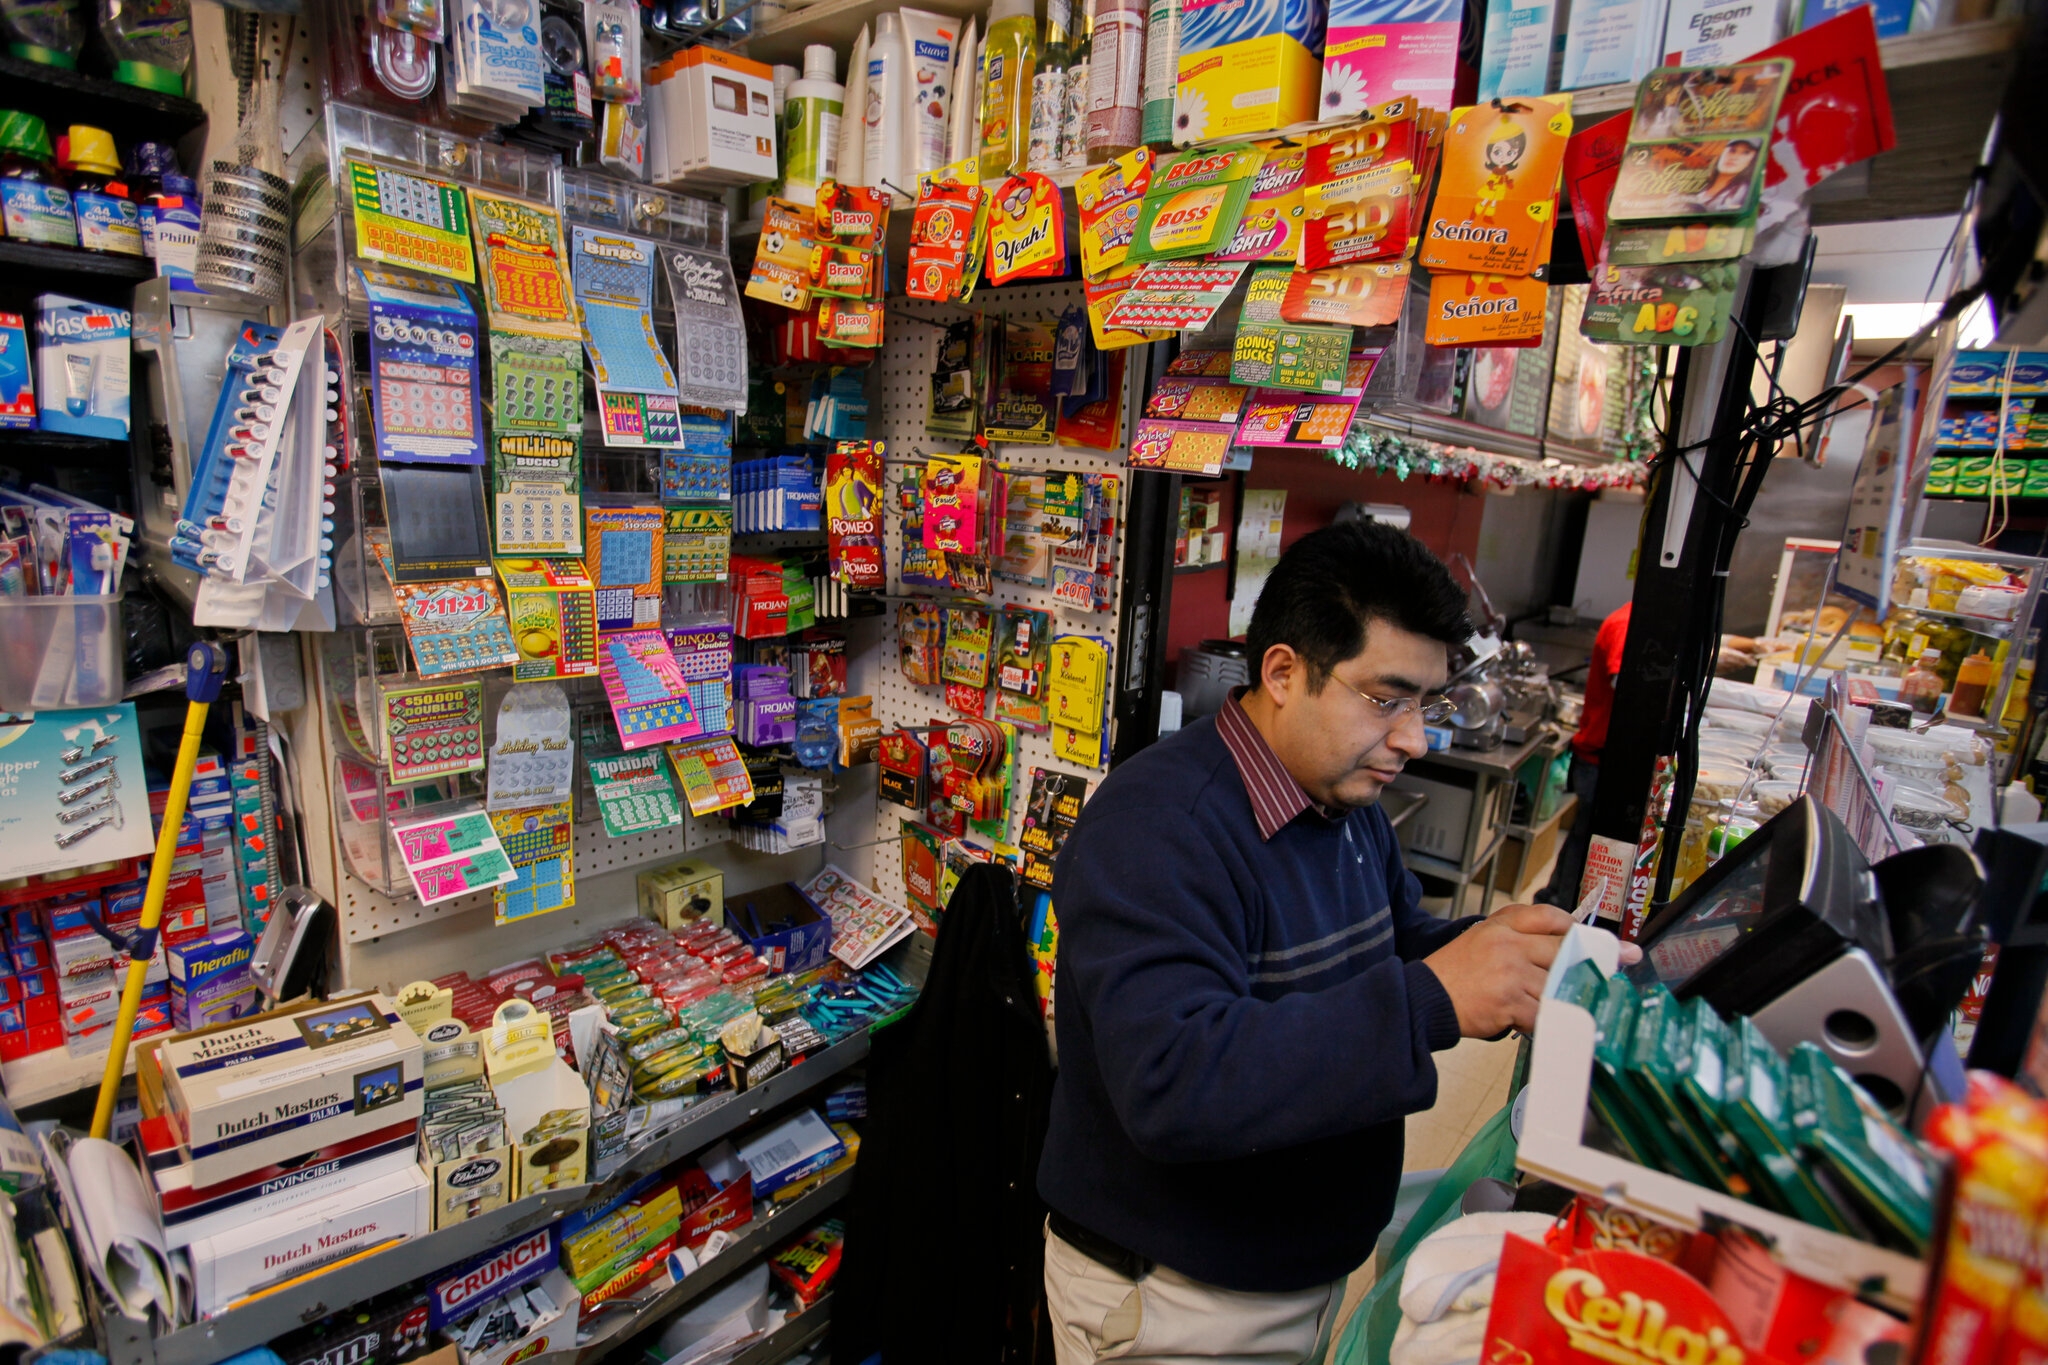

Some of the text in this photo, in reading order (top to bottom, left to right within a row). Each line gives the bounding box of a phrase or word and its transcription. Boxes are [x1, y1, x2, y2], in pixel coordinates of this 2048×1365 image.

[1689, 6, 1752, 30] Epsom
[1699, 23, 1738, 43] Salt
[918, 44, 948, 57] Suave
[1788, 61, 1841, 95] OCK
[1384, 103, 1404, 117] $2
[1550, 122, 1562, 132] $2
[1328, 123, 1391, 162] 3D
[1165, 152, 1237, 181] BOSS
[1334, 157, 1371, 172] NEW YORK
[1168, 174, 1217, 189] NEW YORK
[1253, 169, 1303, 192] RIGHT!
[1320, 167, 1392, 191] PINLESS DIALING
[224, 206, 250, 218] BLACK
[482, 200, 519, 220] SET
[832, 209, 873, 226] Bravo
[1156, 205, 1212, 228] BOSS
[1324, 194, 1396, 242] 3D
[1530, 205, 1542, 215] $2
[507, 220, 550, 244] LIFE
[768, 219, 800, 233] AFRICA
[1170, 225, 1203, 236] NEW YORK
[1431, 219, 1509, 244] Señora
[584, 240, 645, 261] Bingo
[996, 218, 1049, 270] Yeah!
[1331, 239, 1354, 251] NEW
[1355, 233, 1375, 245] YORK
[768, 270, 800, 284] AFRICA
[827, 262, 862, 277] Bravo
[1309, 267, 1378, 301] 3D
[1310, 298, 1351, 309] NEW YORK
[1442, 297, 1519, 320] Señora
[836, 313, 870, 326] Bravo
[1633, 303, 1698, 336] ABC
[1235, 336, 1276, 352] BONUS
[1234, 349, 1274, 365] BUCKS
[1156, 384, 1191, 396] Wicked
[1012, 403, 1043, 414] CARD
[1249, 404, 1297, 417] Amazing
[1138, 430, 1172, 442] Wicked
[500, 435, 574, 458] MILLION
[516, 457, 559, 468] BUCKS
[670, 512, 723, 527] 10X
[832, 518, 874, 535] ROMEO
[843, 560, 878, 575] ROMEO
[903, 561, 938, 573] AFRICA
[514, 598, 553, 619] LEMON
[752, 601, 788, 611] TROJAN
[674, 634, 716, 647] BINGO
[697, 641, 729, 653] Doubler
[404, 701, 465, 717] DOUBLER
[759, 701, 795, 714] TROJAN
[949, 730, 983, 753] maxx
[597, 754, 660, 779] HOLIDAY
[883, 777, 903, 790] BLACK
[951, 795, 974, 814] maxx
[535, 843, 570, 859] $10,000!
[190, 947, 250, 978] Theraflu
[70, 992, 111, 1009] Colgate
[200, 1027, 264, 1048] Dutch
[507, 1029, 532, 1040] GOLD
[192, 1036, 276, 1061] Masters
[224, 1055, 255, 1067] PALMA
[216, 1091, 340, 1139] Dutch Masters
[309, 1104, 341, 1122] PALMA
[261, 1160, 340, 1195] INVINCIBLE
[692, 1210, 736, 1237] Big Red
[263, 1220, 378, 1270] Dutch Masters
[445, 1232, 548, 1305] CRUNCH
